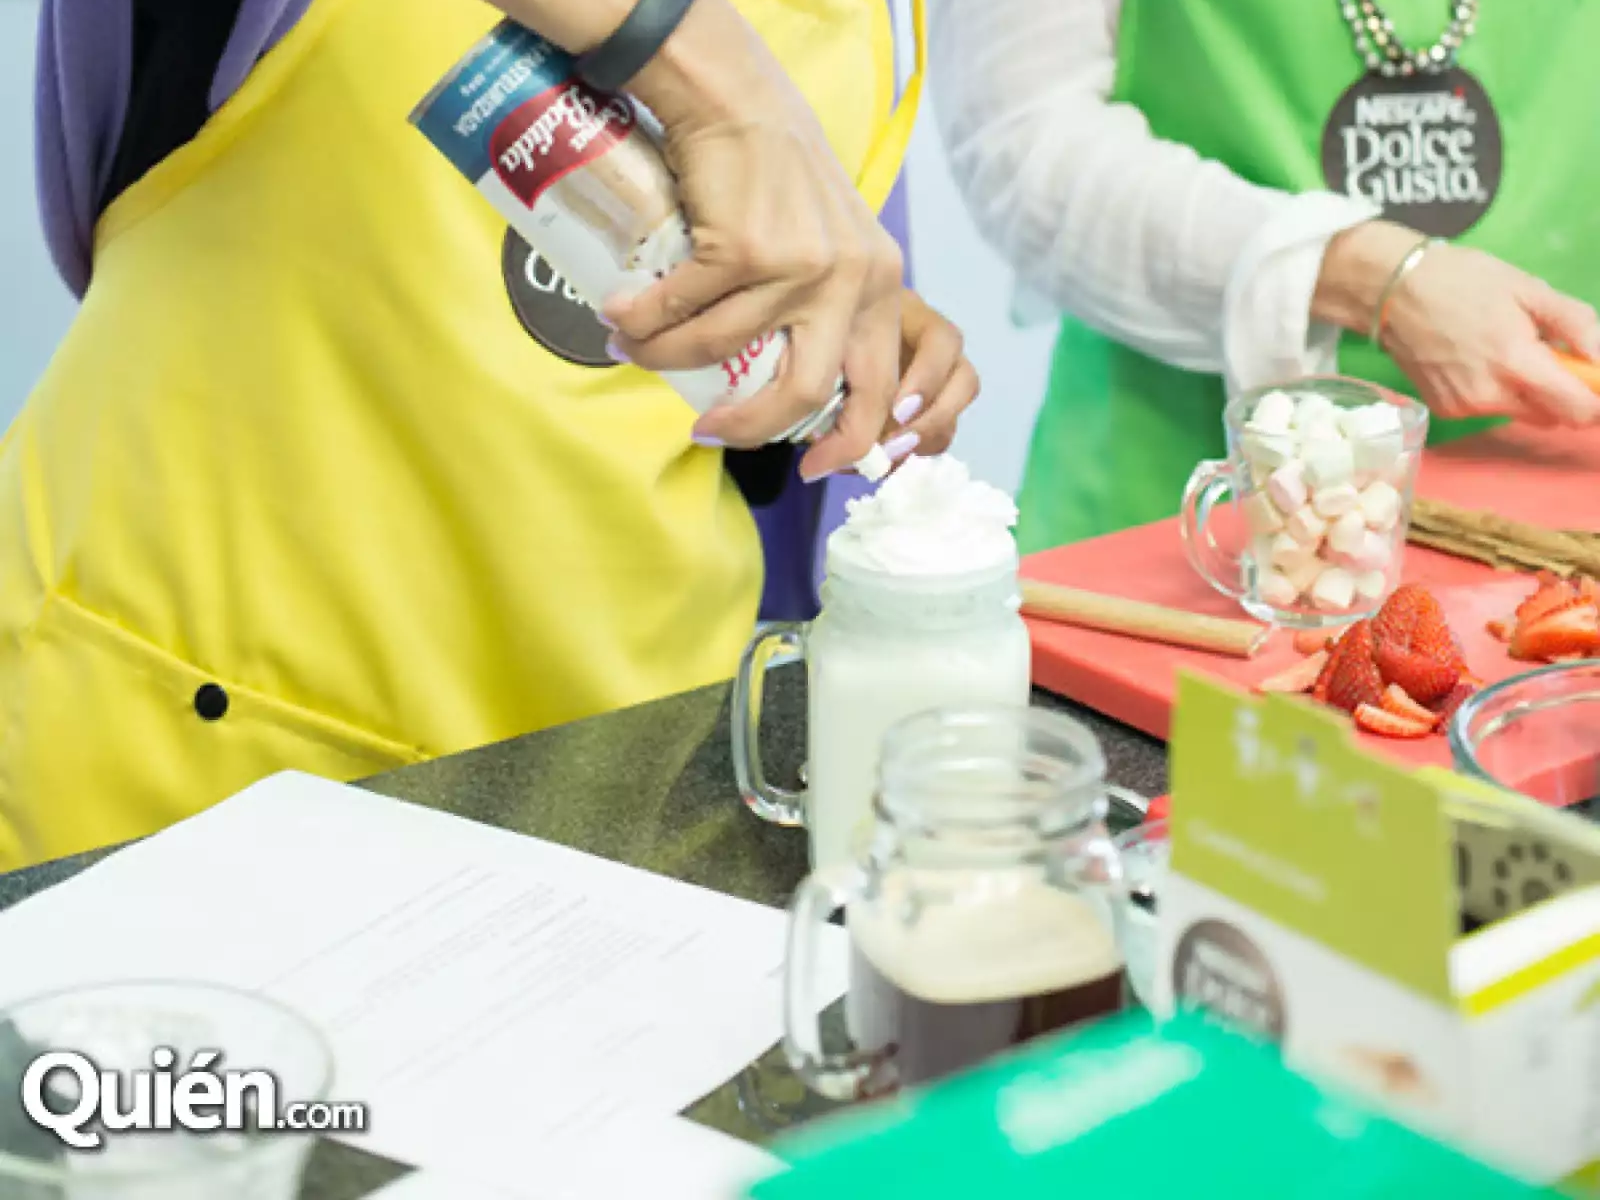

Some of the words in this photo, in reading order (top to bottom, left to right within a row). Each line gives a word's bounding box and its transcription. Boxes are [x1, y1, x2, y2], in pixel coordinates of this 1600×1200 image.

[500, 85, 597, 172] Batida
[1340, 119, 1476, 168] Dolce
[1345, 158, 1481, 204] Gusto
